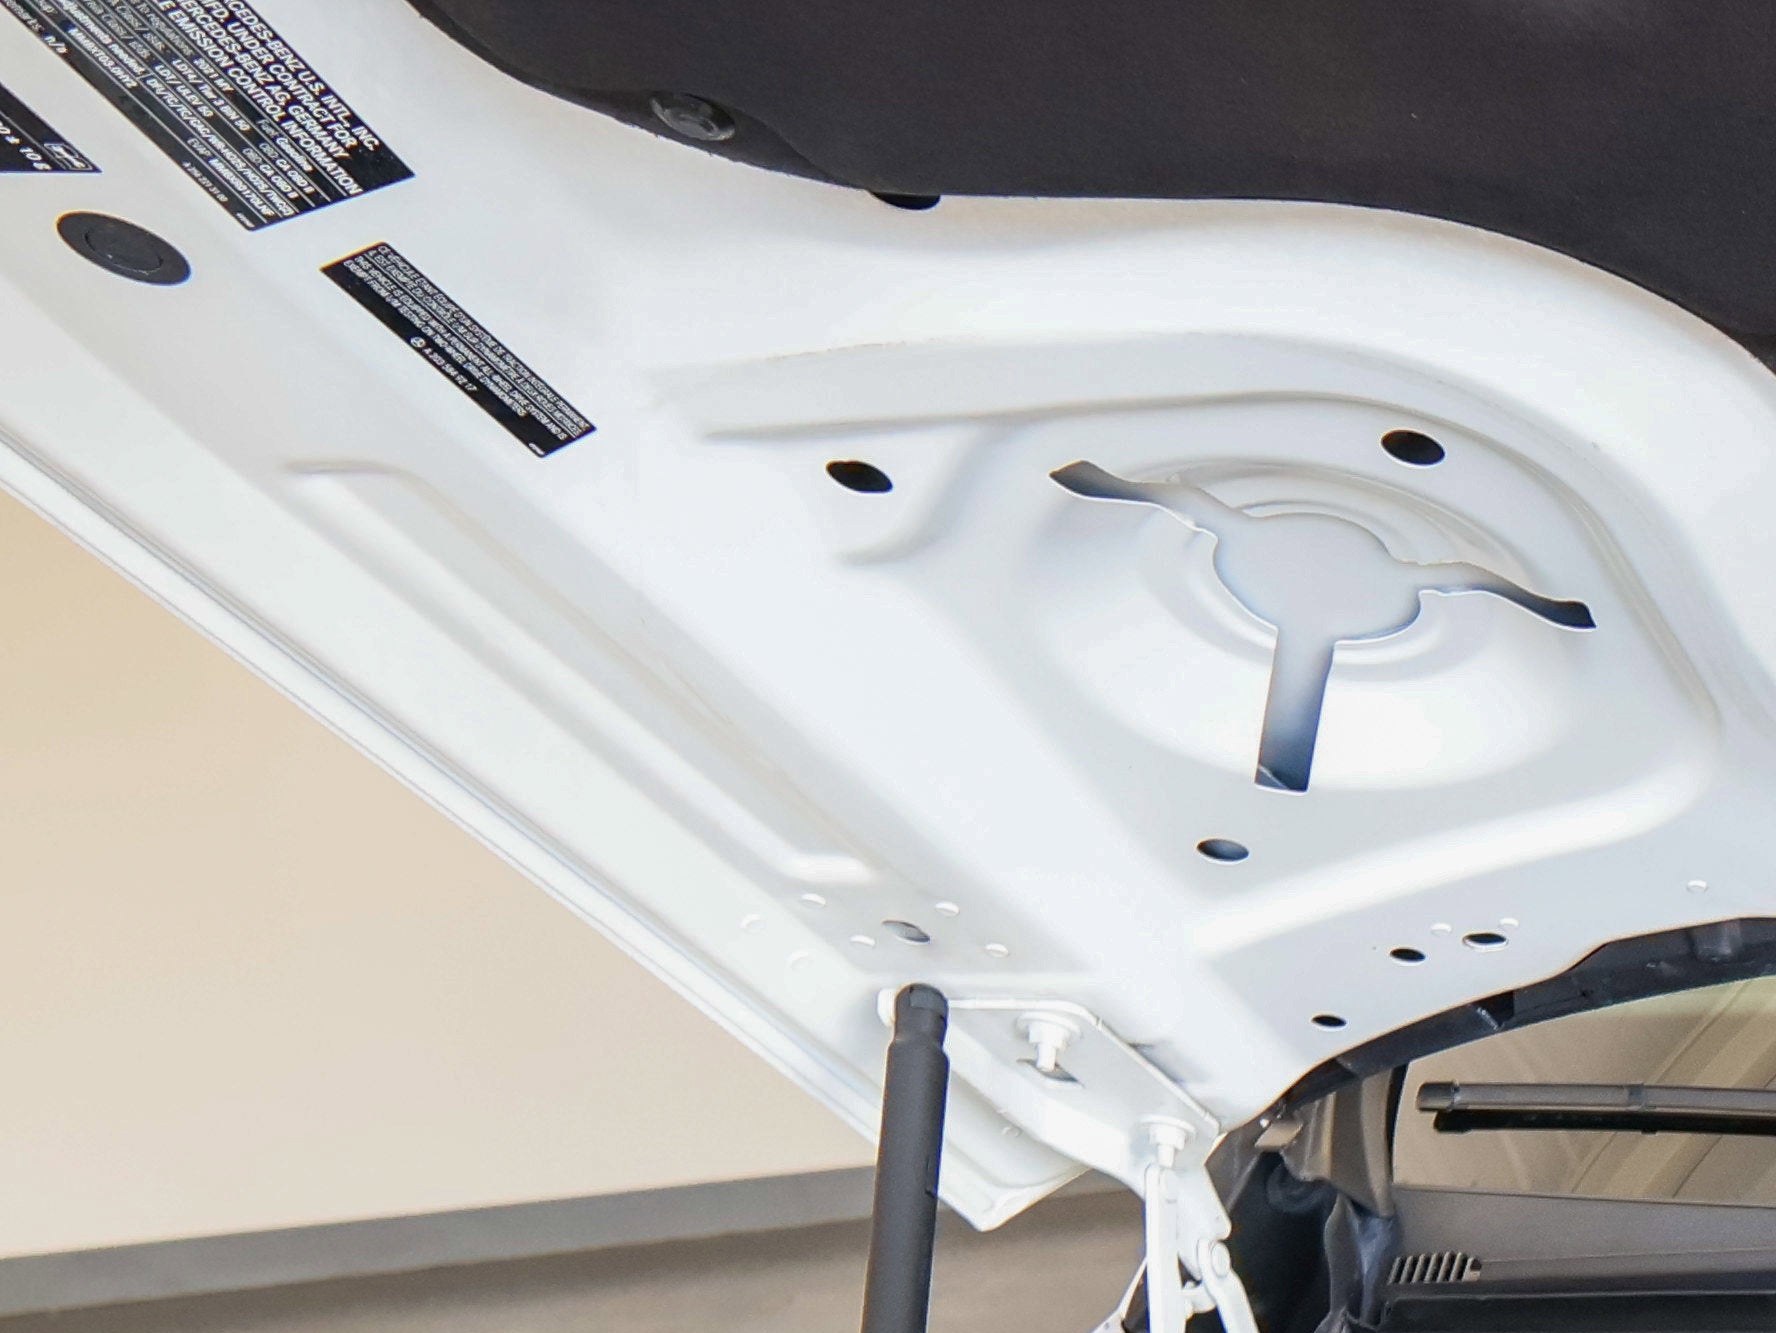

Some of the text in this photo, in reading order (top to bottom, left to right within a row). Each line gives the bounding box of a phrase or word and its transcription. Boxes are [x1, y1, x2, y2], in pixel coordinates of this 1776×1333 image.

[166, 9, 363, 194] EMISSION CONTROL INFORMATION
[212, 78, 235, 93] MY
[272, 136, 316, 172] Gasoline
[225, 21, 276, 64] UNDER
[266, 62, 335, 124] CONTRACT
[325, 123, 358, 148] FOR
[263, 83, 295, 106] AG,
[285, 104, 350, 160] GERMANY
[295, 70, 328, 95] U.S.
[349, 126, 383, 151] INC.
